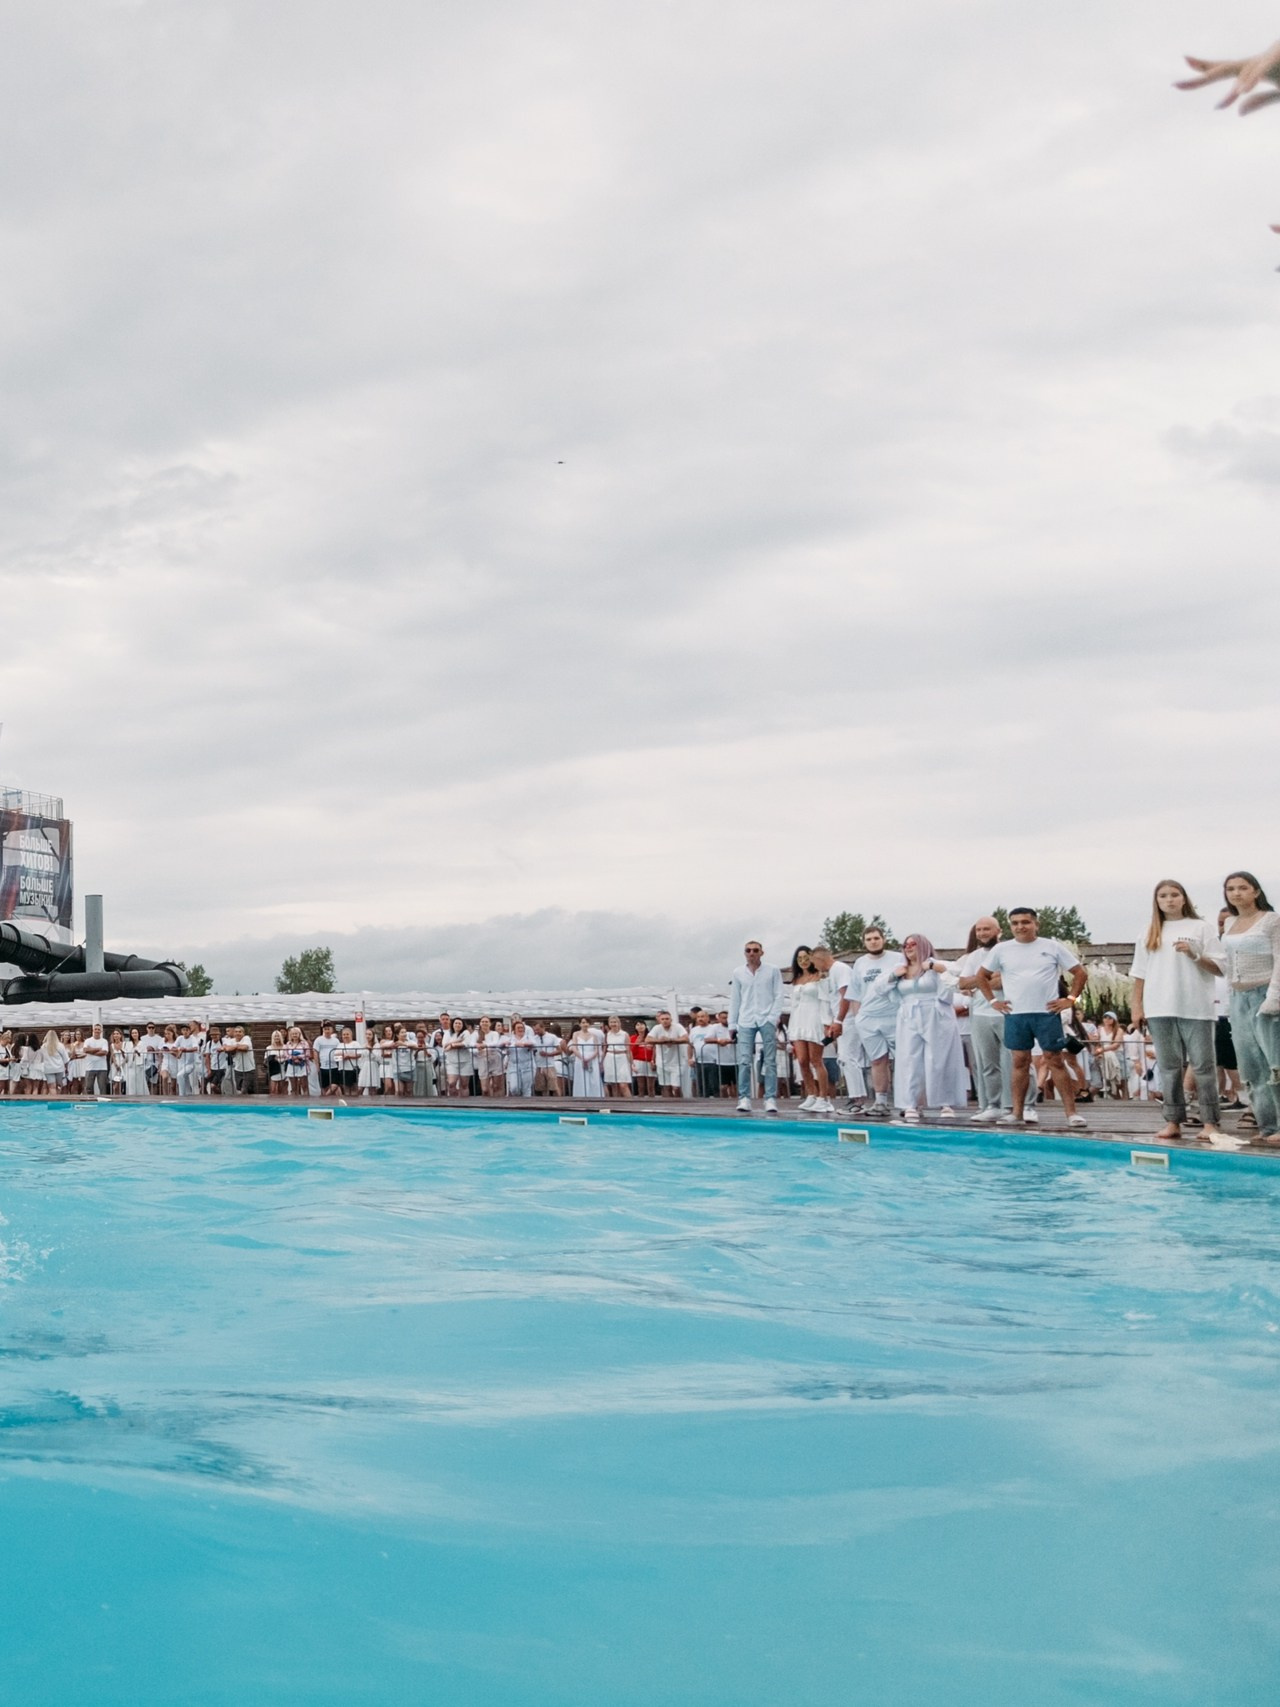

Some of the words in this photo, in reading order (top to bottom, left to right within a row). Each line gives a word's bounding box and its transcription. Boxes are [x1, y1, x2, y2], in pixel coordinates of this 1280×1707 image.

[19, 835, 53, 853] БОЛЬШЕ
[20, 851, 54, 871] ХИТОВ!
[20, 876, 54, 893] БОЛЬШЕ
[19, 891, 54, 907] МУЗЫКИ!
